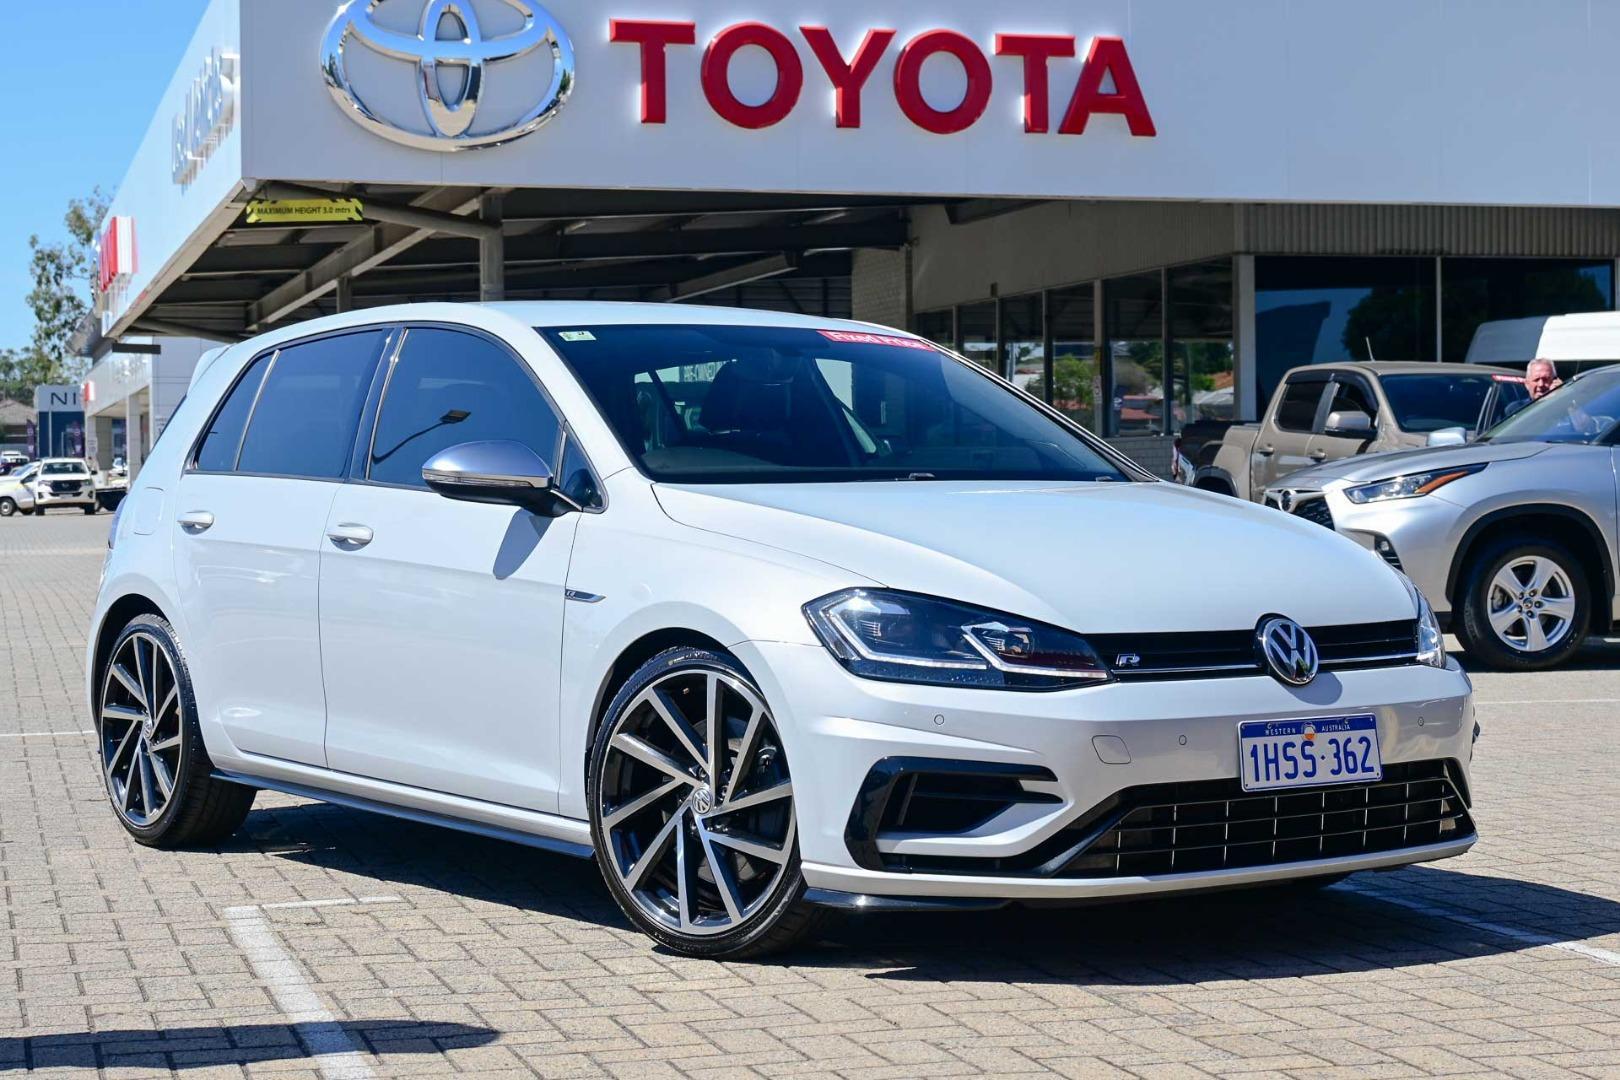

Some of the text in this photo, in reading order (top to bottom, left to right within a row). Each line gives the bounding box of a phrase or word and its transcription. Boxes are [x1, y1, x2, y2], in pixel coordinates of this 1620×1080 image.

[609, 18, 1157, 137] TOYOTA
[257, 207, 294, 215] MAXIMUM
[1115, 653, 1141, 667] R
[1264, 724, 1351, 736] WESTERN AUSTRALIA
